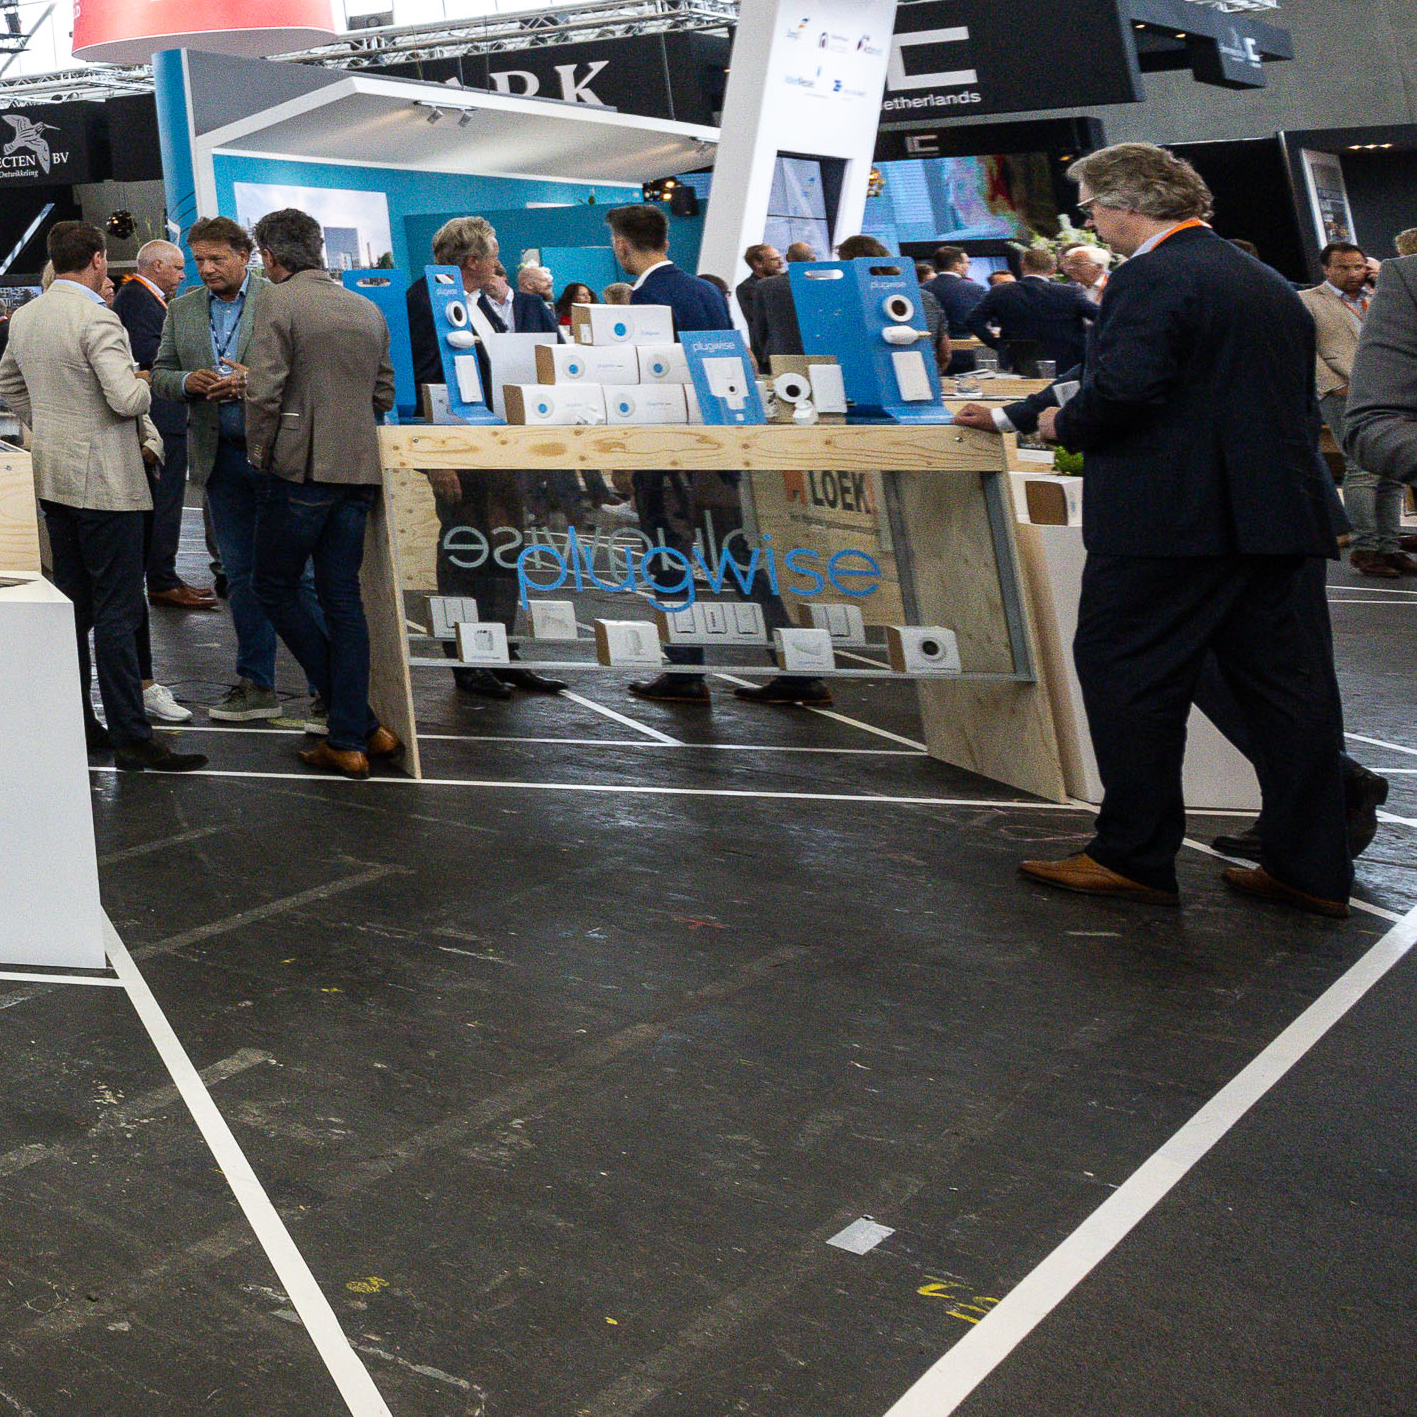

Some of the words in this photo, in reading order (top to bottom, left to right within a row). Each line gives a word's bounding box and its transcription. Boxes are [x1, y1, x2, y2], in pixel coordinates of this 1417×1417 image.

[881, 90, 981, 111] etherlands
[52, 151, 69, 164] BV
[692, 339, 735, 351] plugwise
[517, 534, 882, 612] plugwise
